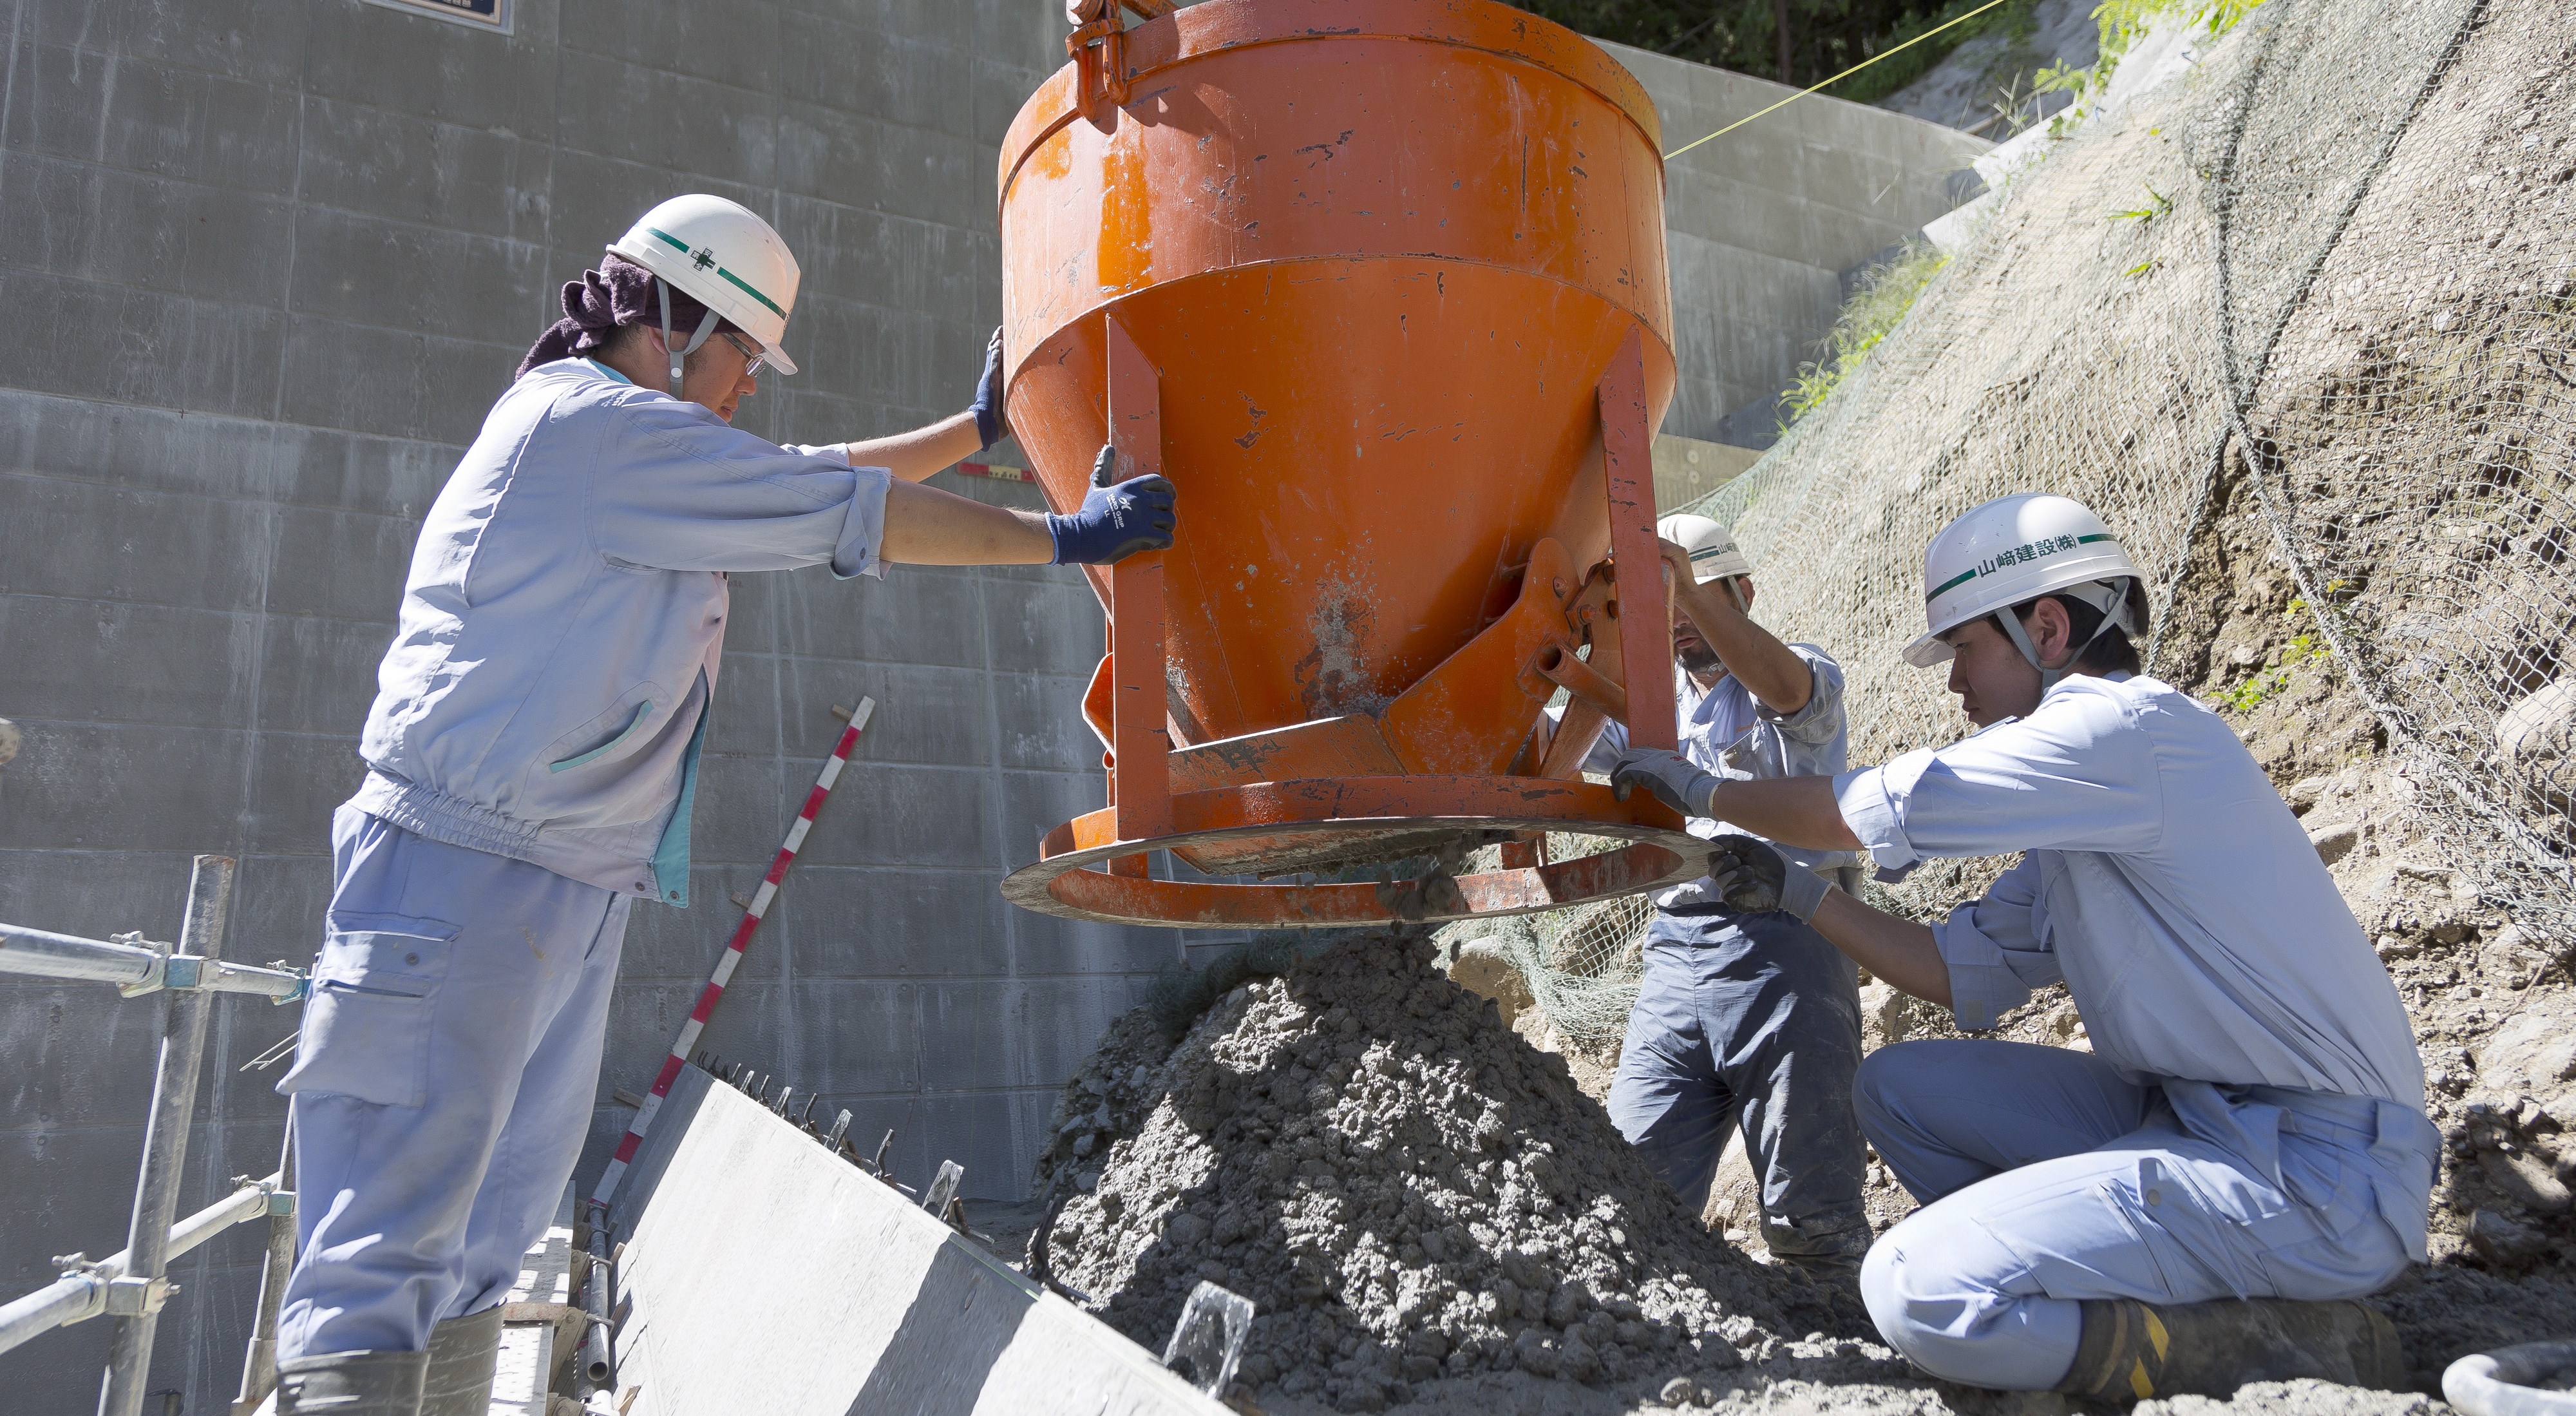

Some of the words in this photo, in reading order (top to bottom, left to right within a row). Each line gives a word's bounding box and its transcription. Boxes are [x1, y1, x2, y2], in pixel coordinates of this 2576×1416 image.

[1104, 510, 1110, 518] LL
[1109, 493, 1119, 510] HARD
[1116, 511, 1124, 527] GRIP
